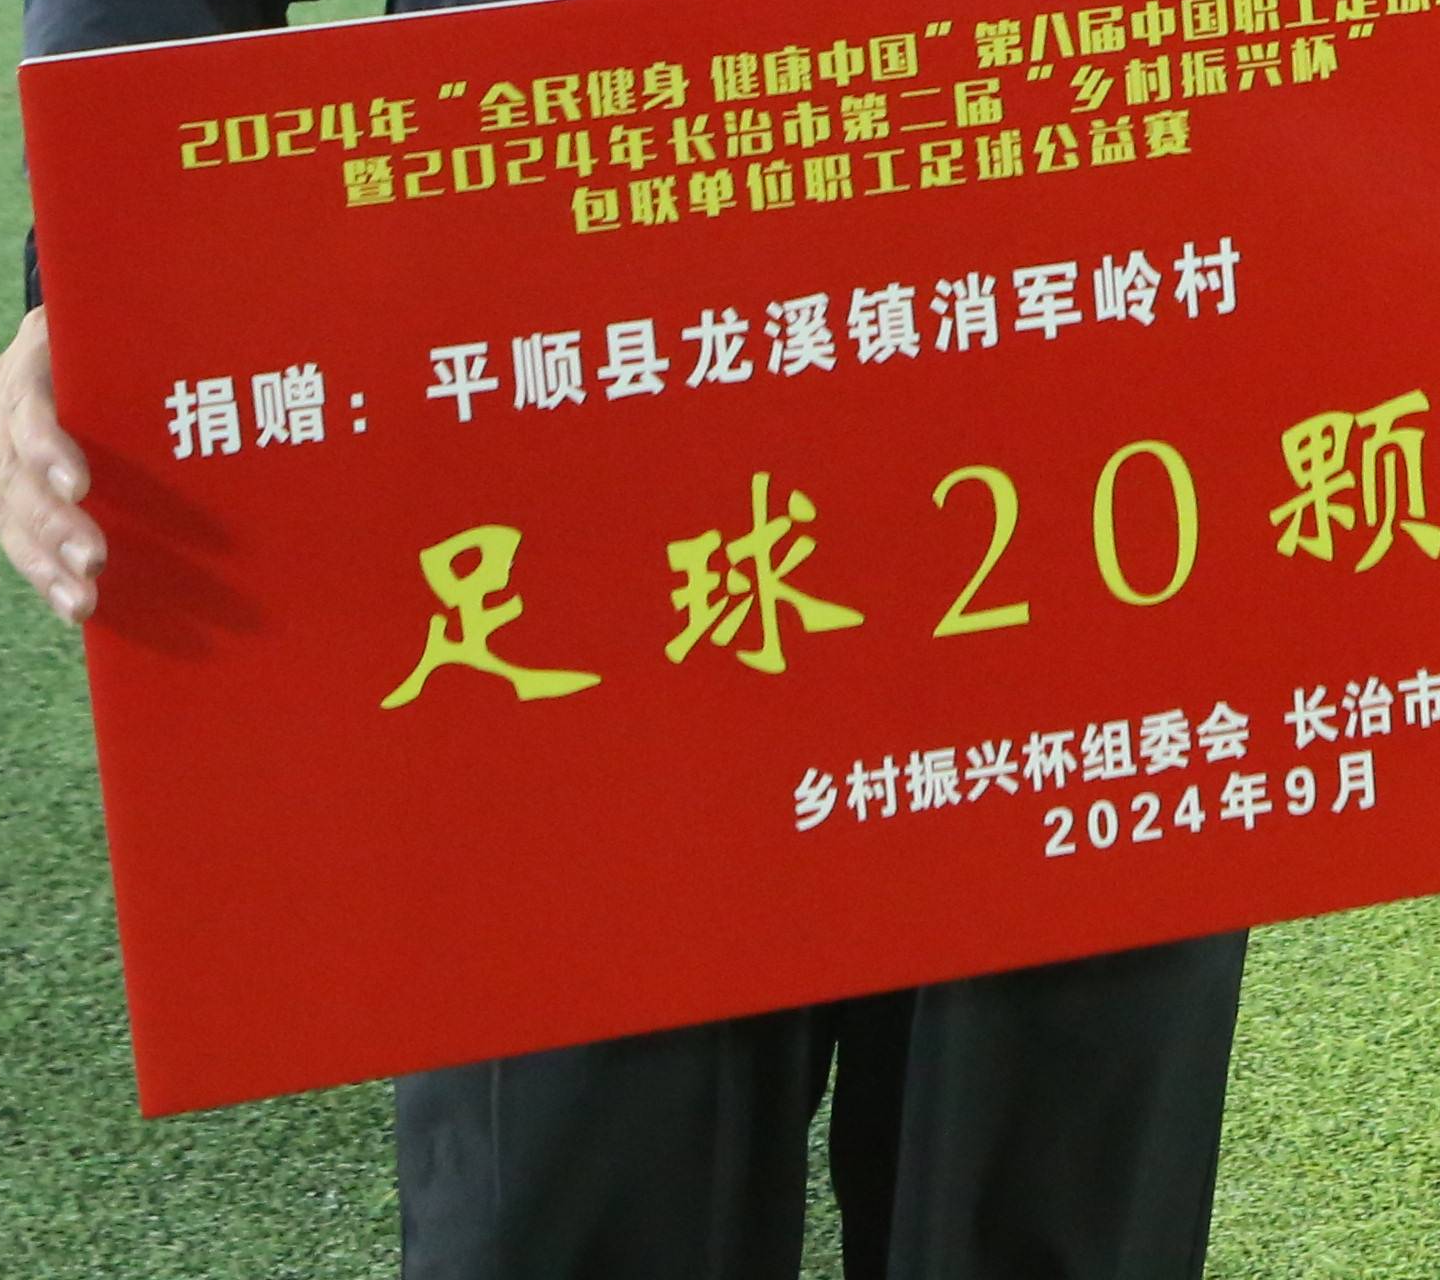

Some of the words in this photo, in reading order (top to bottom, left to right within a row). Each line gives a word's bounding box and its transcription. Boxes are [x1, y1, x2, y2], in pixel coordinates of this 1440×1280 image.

[570, 109, 1192, 234] 包联单位职工足球公益赛
[793, 701, 1250, 832] 乡村振兴杯组委会
[1043, 749, 1376, 858] 2024年9月
